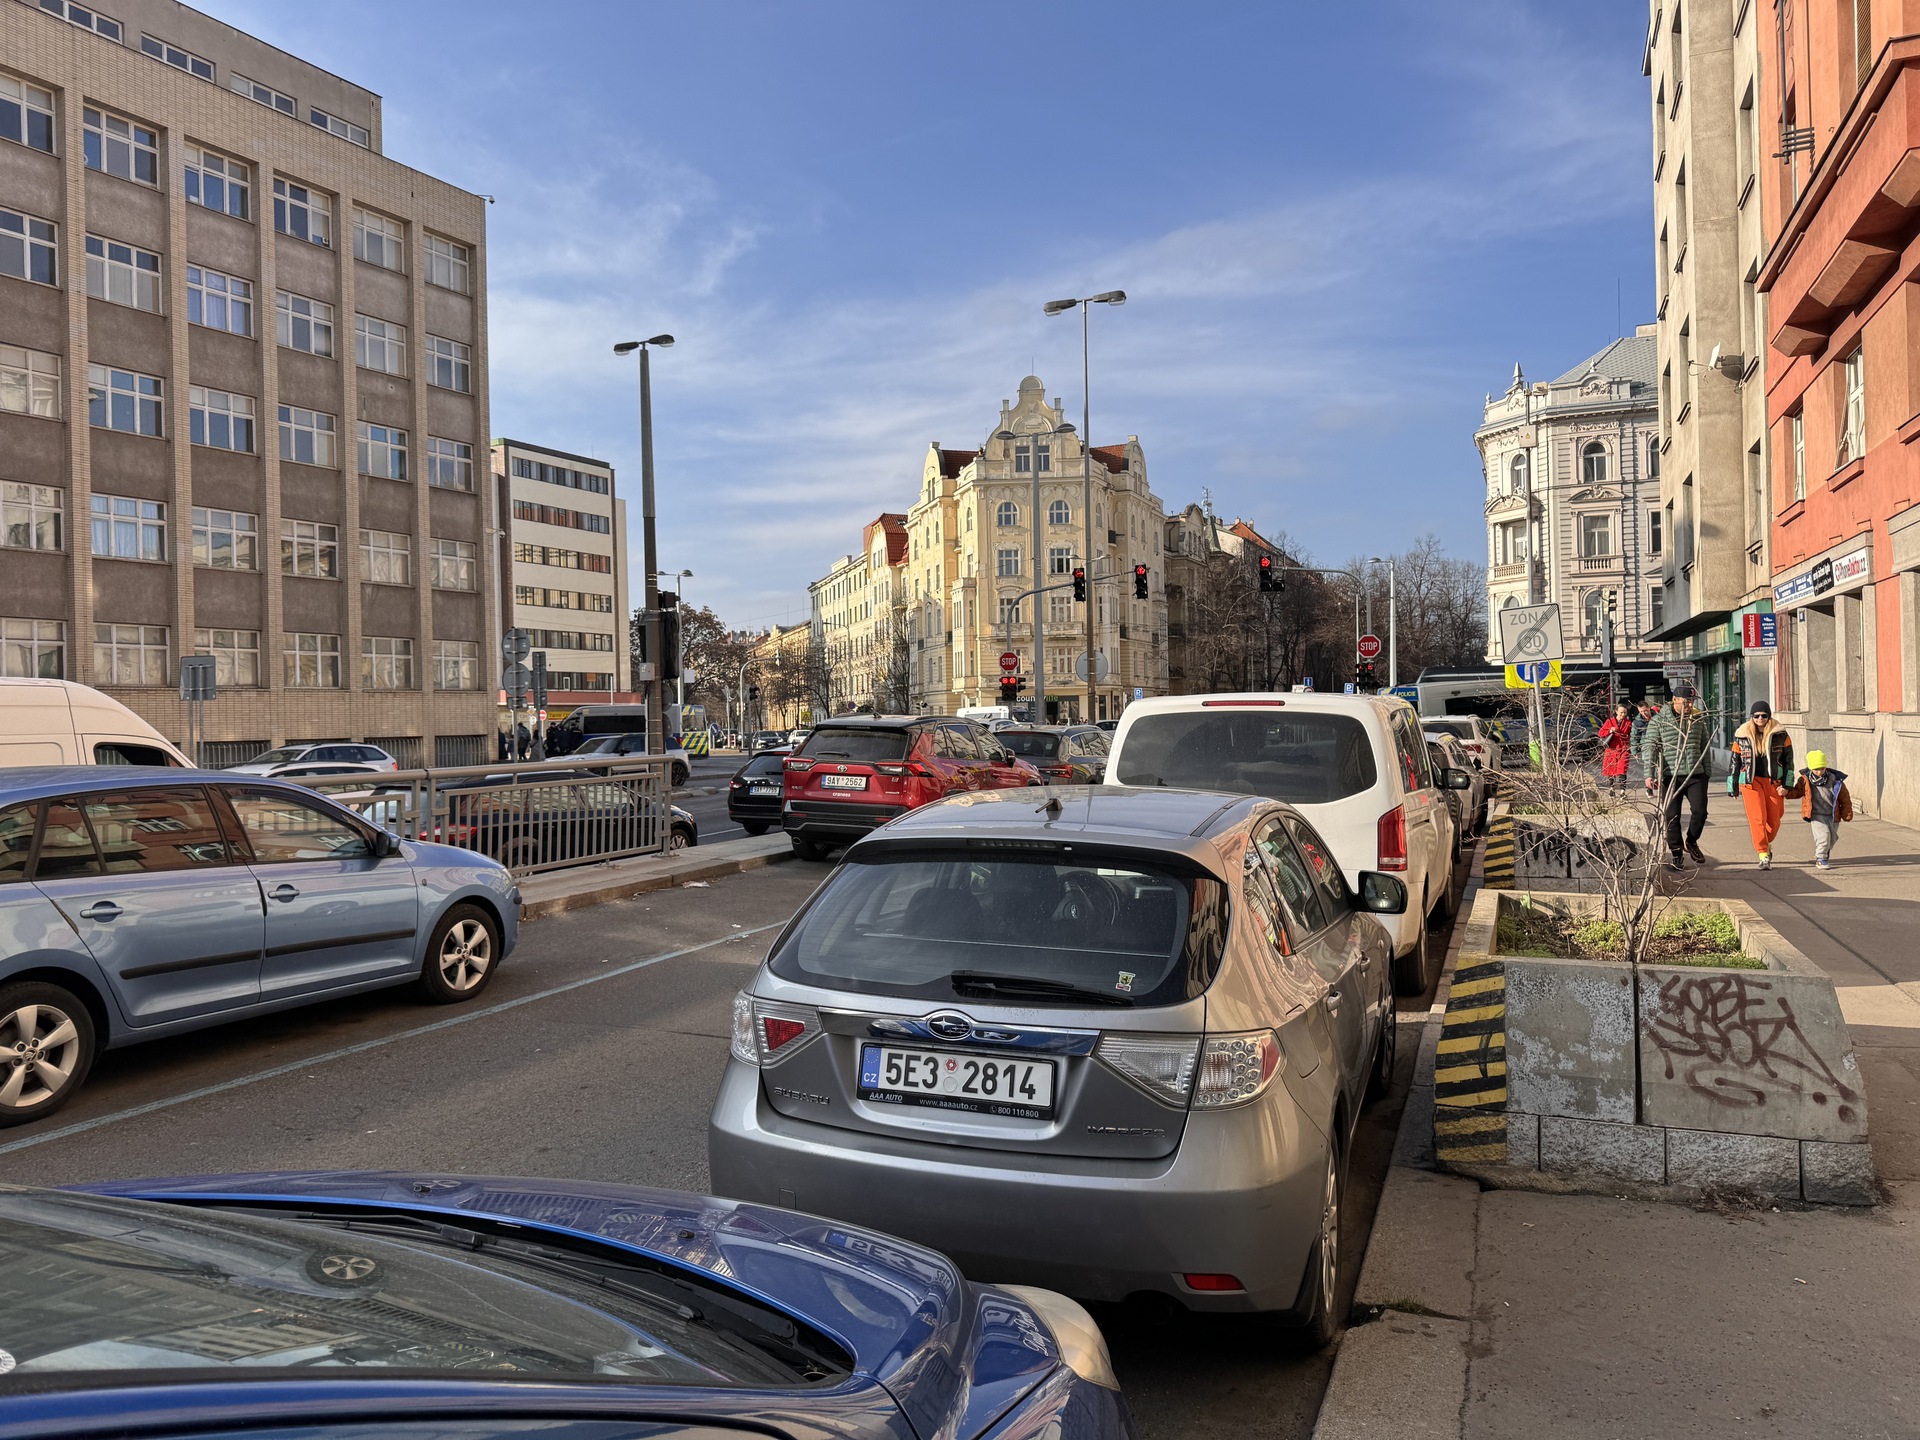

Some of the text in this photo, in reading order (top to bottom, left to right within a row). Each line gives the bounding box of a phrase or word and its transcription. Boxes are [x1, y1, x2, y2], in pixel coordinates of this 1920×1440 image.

[1360, 643, 1378, 651] STOP
[1001, 658, 1017, 666] STOP
[827, 776, 863, 787] 9AY 2562
[863, 1072, 877, 1083] CZ
[885, 1052, 1036, 1100] 5E3 2814
[774, 1086, 830, 1105] SUBARU
[869, 1092, 903, 1102] AAA AUTO
[919, 1098, 978, 1111] www.aaaauto.cz
[997, 1107, 1039, 1118] 800 110 800
[1087, 1126, 1165, 1138] IMPREZA
